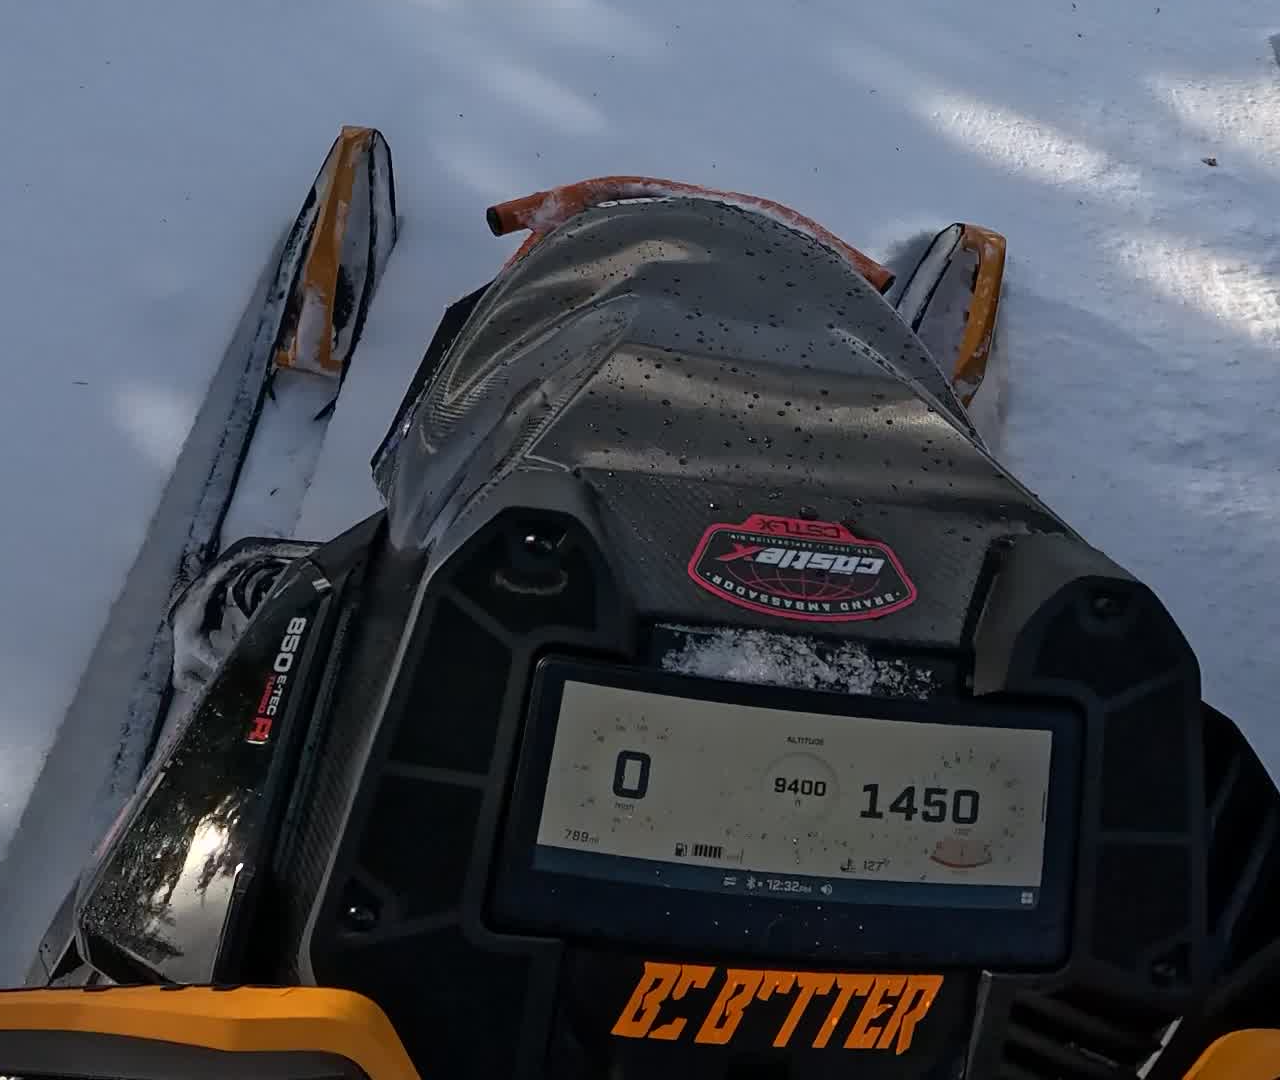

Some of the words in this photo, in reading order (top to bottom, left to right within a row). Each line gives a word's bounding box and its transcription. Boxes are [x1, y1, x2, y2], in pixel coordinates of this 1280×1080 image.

[711, 575, 831, 612] AMBASSADOR
[840, 593, 896, 612] BRAND
[273, 617, 307, 673] 850
[266, 674, 288, 717] E-TEC
[612, 749, 652, 800] 0
[774, 777, 827, 797] 9400
[859, 783, 980, 825] 1450
